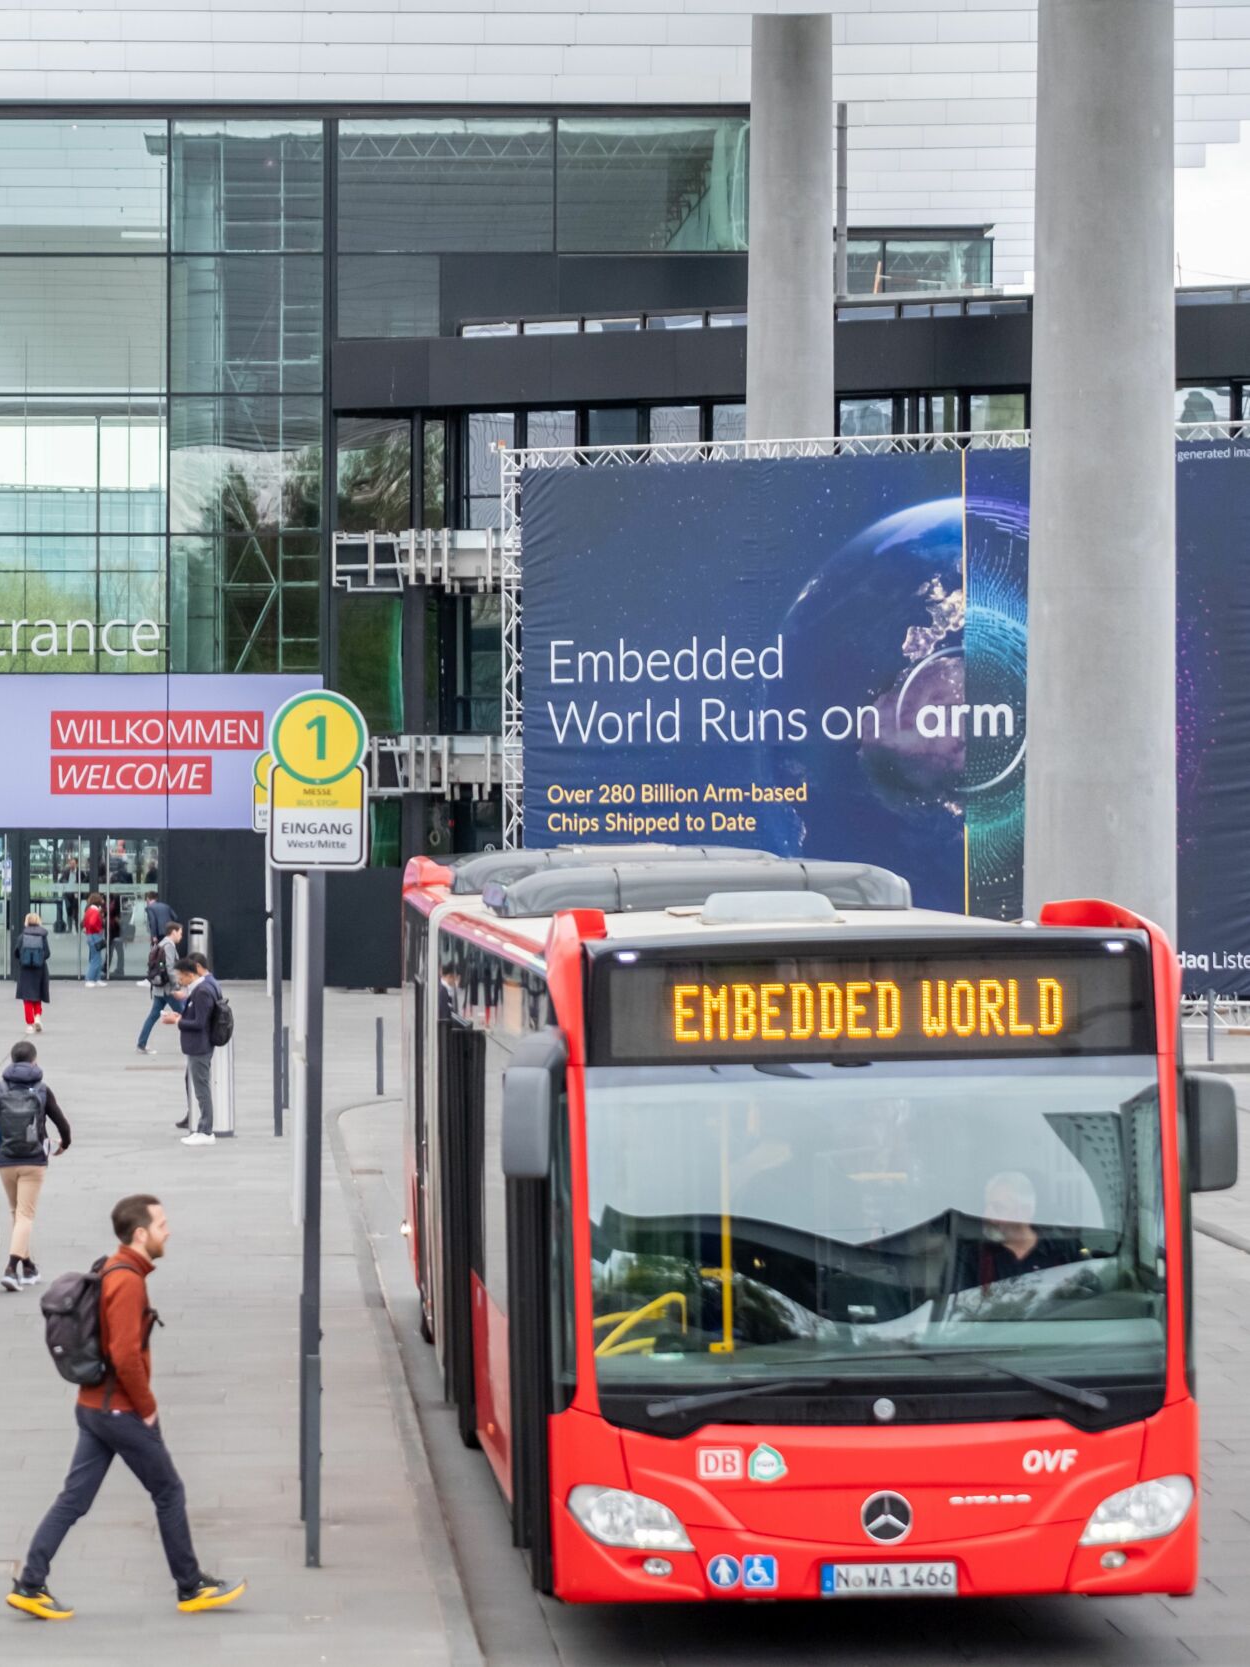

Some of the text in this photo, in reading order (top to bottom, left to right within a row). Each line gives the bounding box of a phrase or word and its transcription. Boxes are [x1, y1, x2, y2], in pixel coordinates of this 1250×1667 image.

[549, 634, 784, 684] Embedded
[56, 718, 259, 745] WILLKOMMEN
[547, 697, 1015, 744] World Runs on arm
[305, 715, 327, 760] 1
[57, 763, 206, 790] WELCOME
[303, 788, 332, 796] MESSE
[547, 783, 808, 804] Over 280 Billion Arm-based
[281, 822, 354, 836] EINGANG
[547, 812, 757, 835] Chips Shipped to Date
[287, 840, 348, 850] West/Mitte
[1212, 950, 1250, 970] Liste
[673, 978, 1063, 1042] EMBEDDED WORLD
[704, 1452, 737, 1474] DB
[1022, 1449, 1078, 1475] OVF
[899, 1565, 953, 1587] 1466
